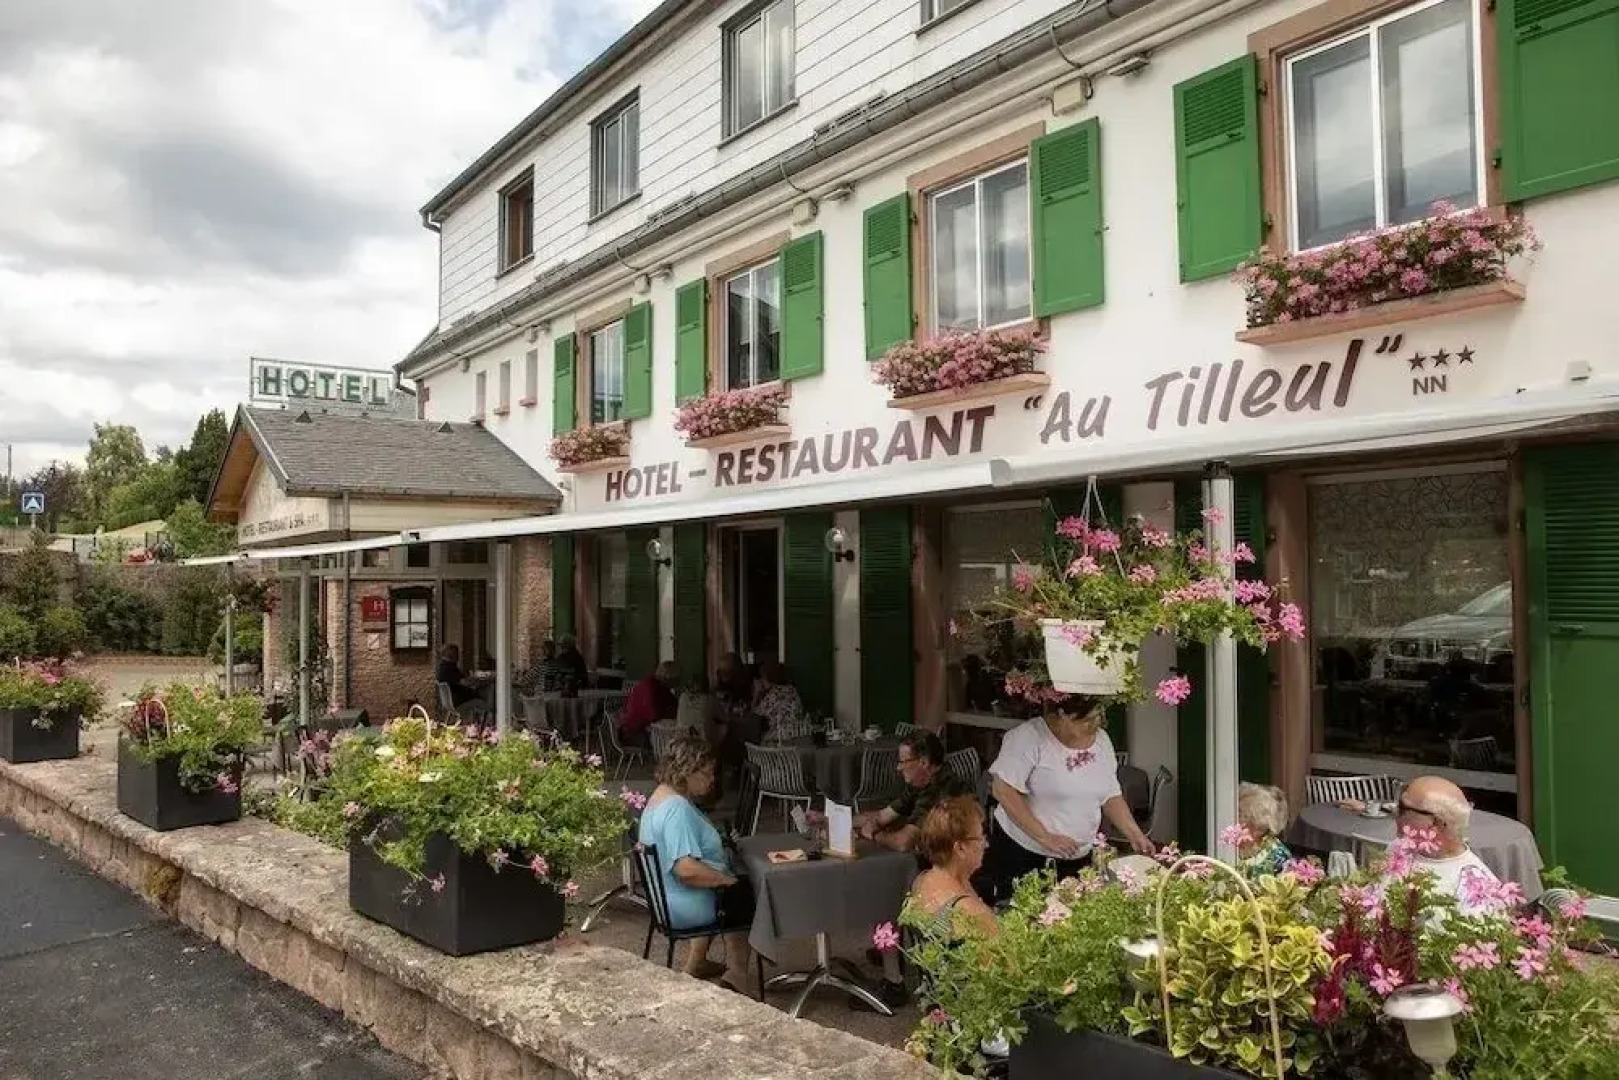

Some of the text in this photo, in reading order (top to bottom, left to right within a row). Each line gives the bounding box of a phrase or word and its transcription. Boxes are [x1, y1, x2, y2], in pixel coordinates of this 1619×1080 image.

[262, 366, 387, 403] HOTEL
[1412, 374, 1448, 396] NN
[605, 460, 683, 502] HOTEL
[714, 404, 996, 487] RESTAURANT
